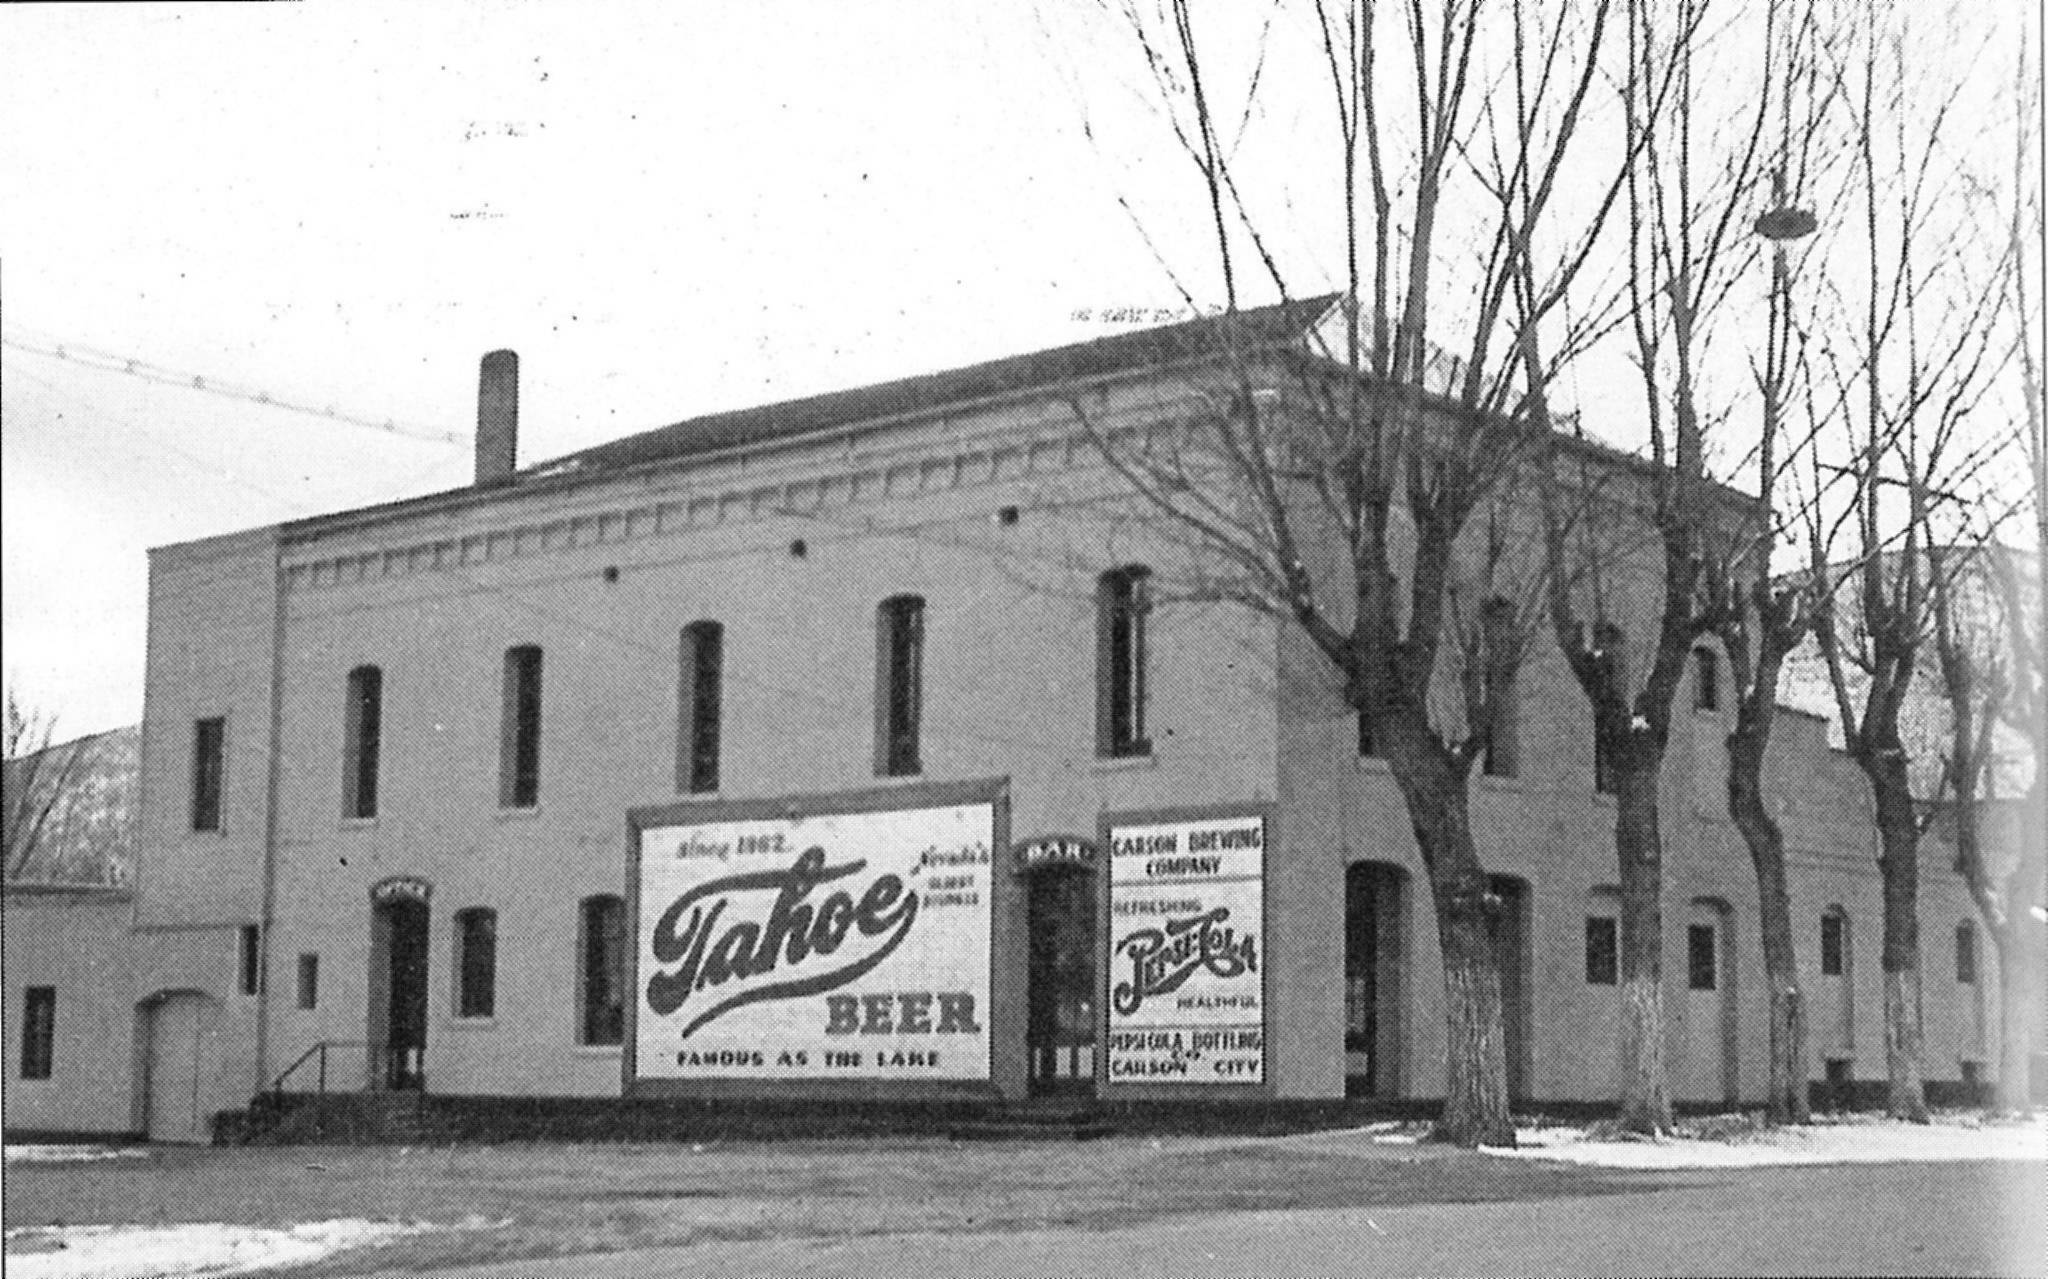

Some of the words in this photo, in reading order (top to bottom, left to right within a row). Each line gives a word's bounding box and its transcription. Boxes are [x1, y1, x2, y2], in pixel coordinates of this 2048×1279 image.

[1026, 841, 1081, 862] BAR
[1113, 834, 1178, 857] CARSON
[1189, 827, 1261, 851] BREWING
[1146, 857, 1222, 875] COMPANY
[647, 845, 919, 1039] Tahoe
[824, 991, 982, 1035] BEER
[676, 1050, 764, 1067] FAMOUS
[776, 1050, 808, 1067] AS
[824, 1050, 862, 1067] THE
[876, 1050, 939, 1067] LAKE
[1111, 1060, 1188, 1076] CARSON
[1213, 1060, 1259, 1075] CITY
